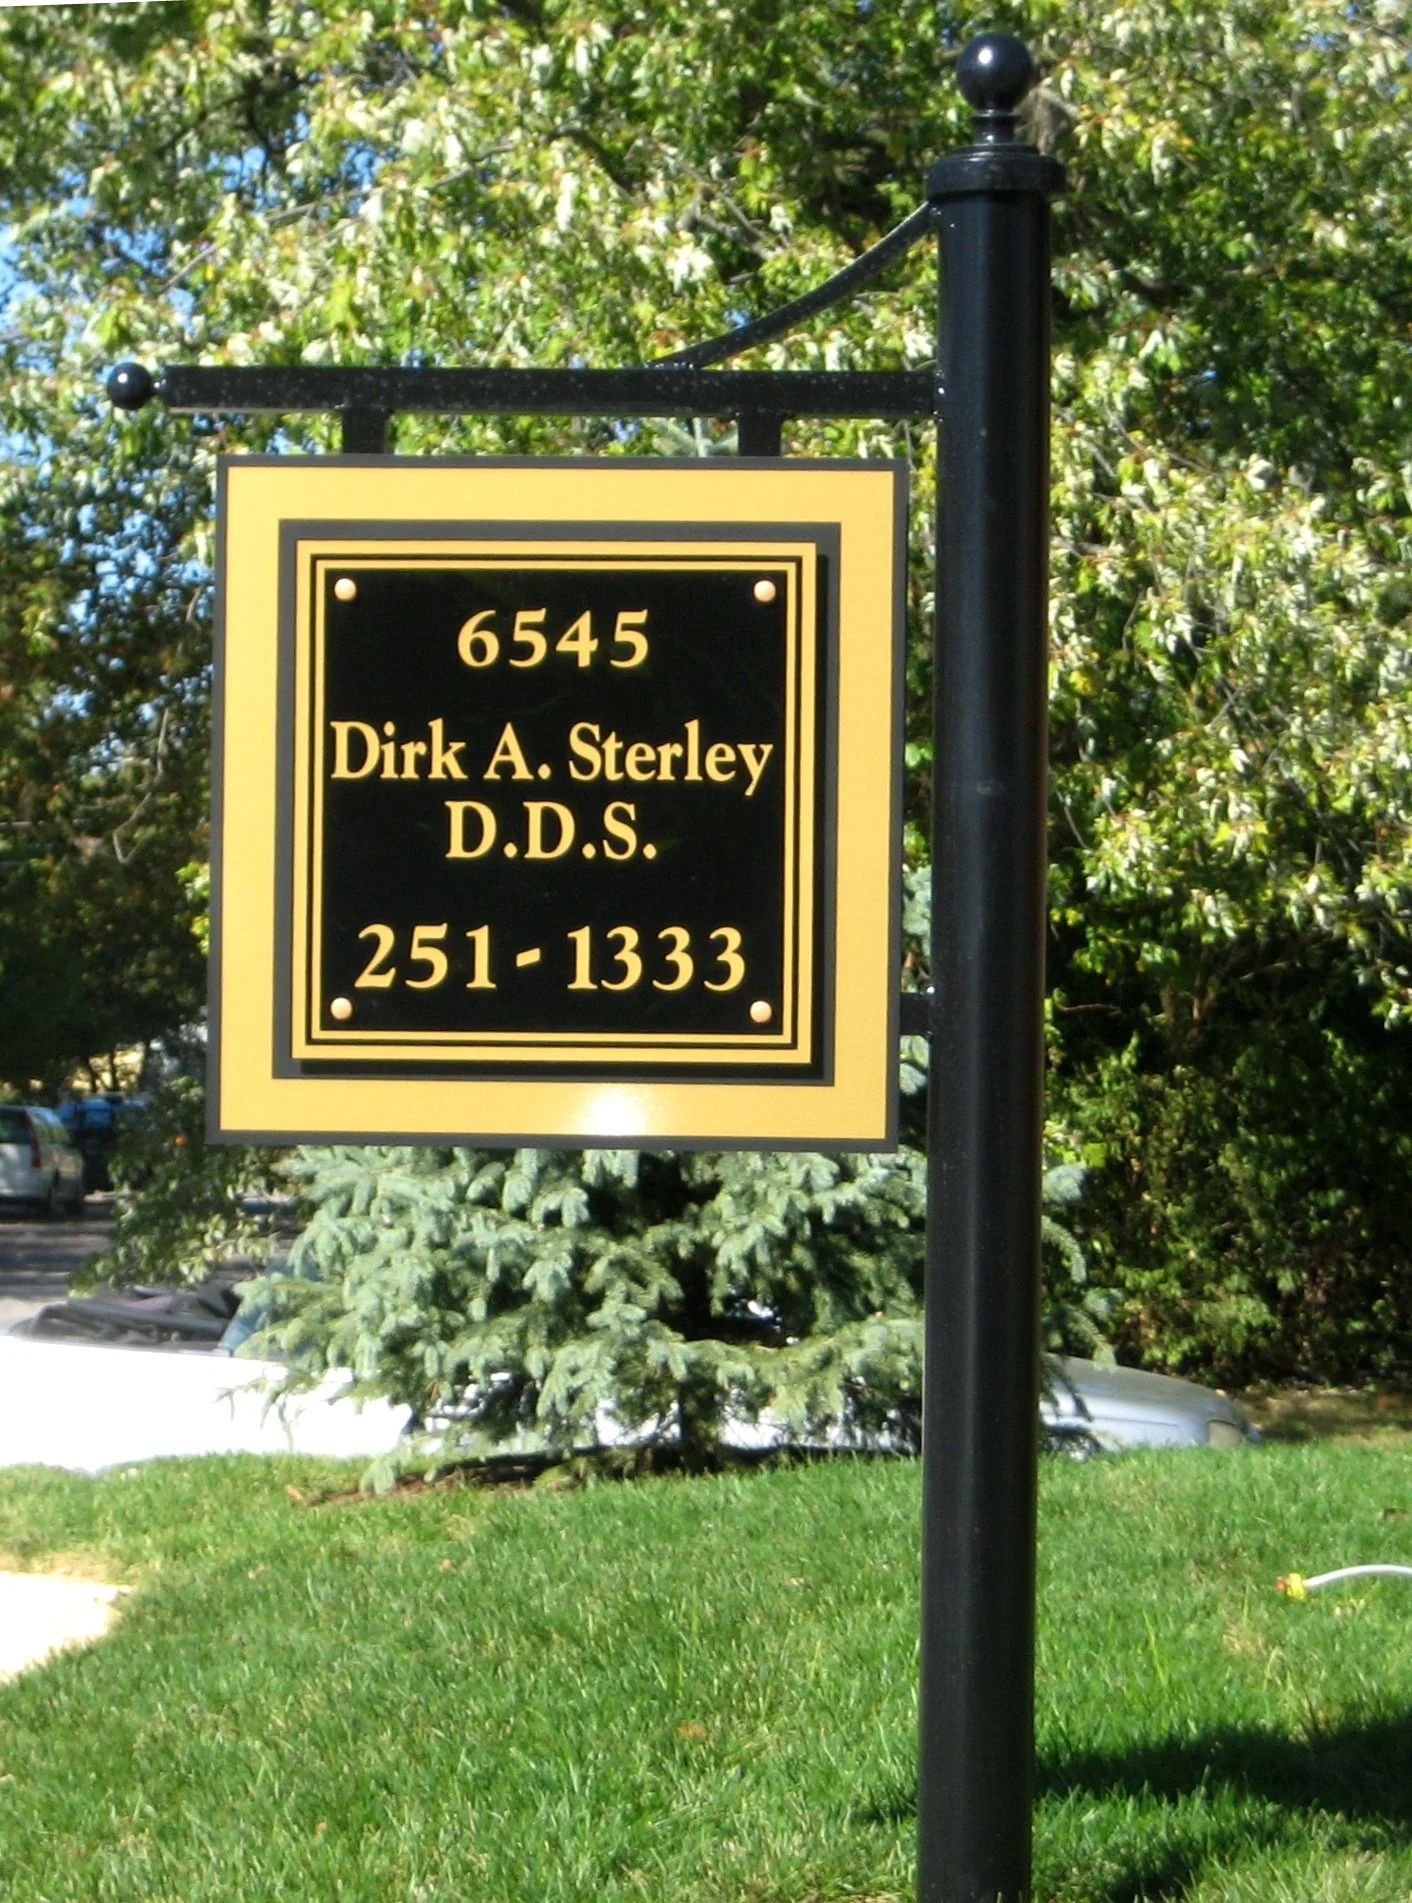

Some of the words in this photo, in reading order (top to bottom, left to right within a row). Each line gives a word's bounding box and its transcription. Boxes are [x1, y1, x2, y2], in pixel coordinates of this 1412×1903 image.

[457, 608, 649, 669] 6545
[330, 717, 469, 781] Dirk
[483, 721, 552, 781] A.
[568, 719, 775, 798] Sterley
[444, 800, 657, 861] D.D.S.
